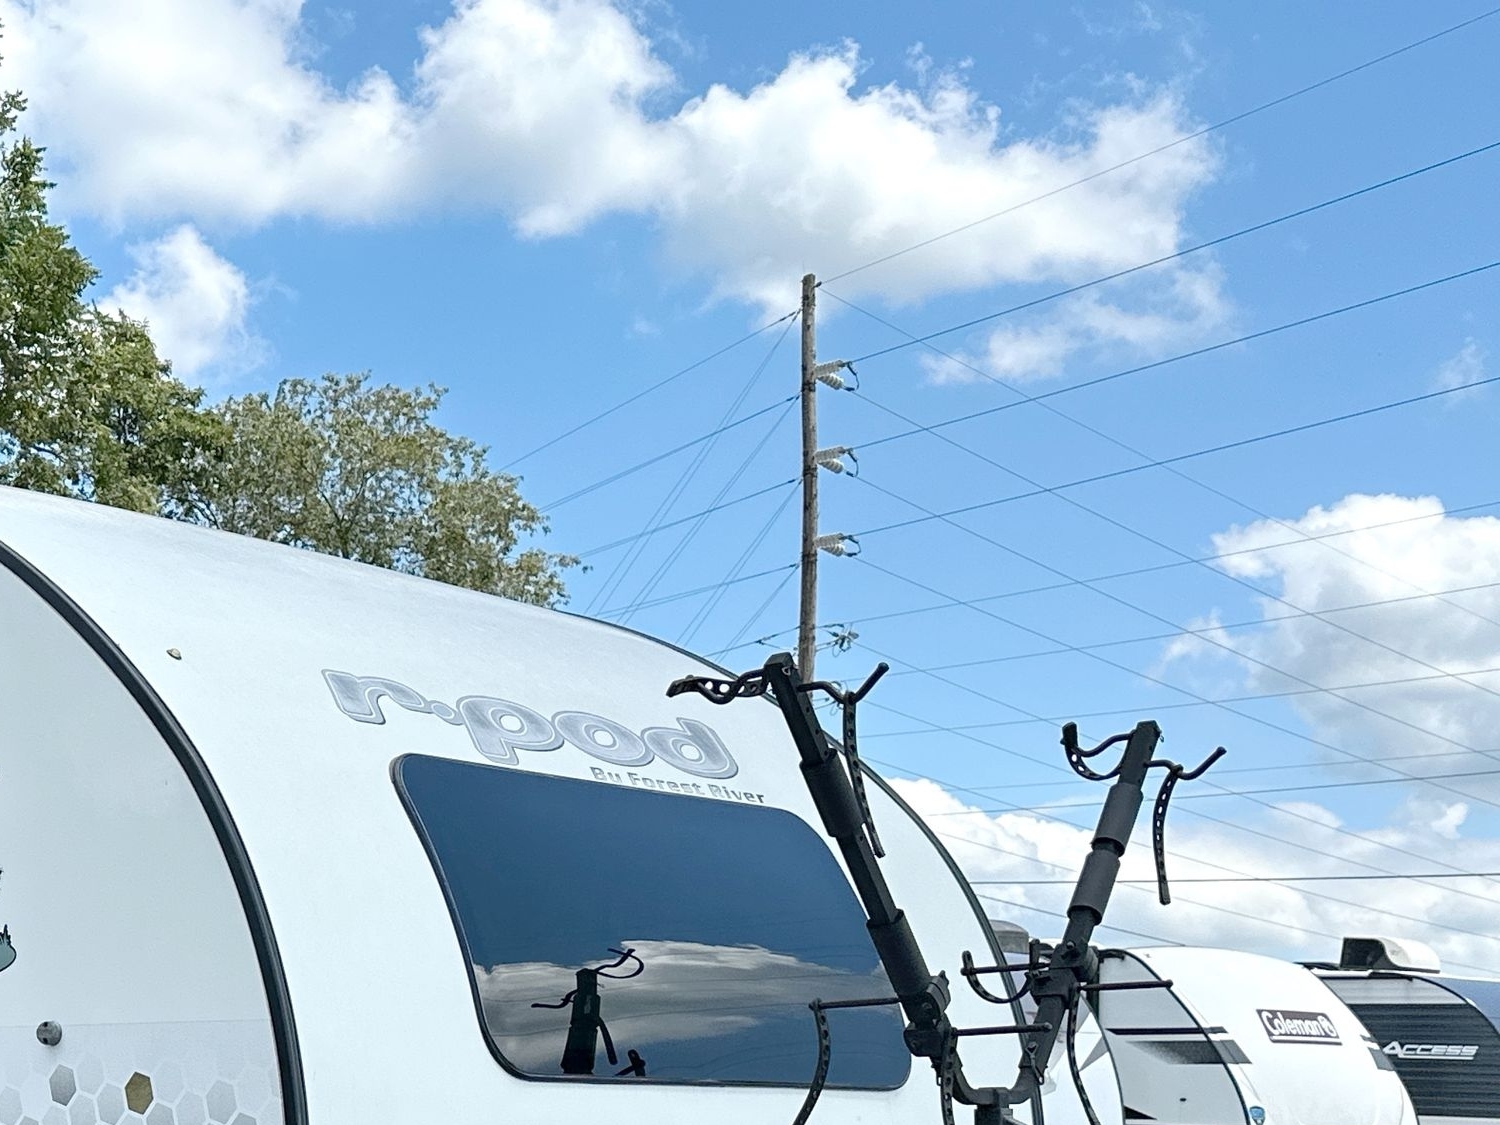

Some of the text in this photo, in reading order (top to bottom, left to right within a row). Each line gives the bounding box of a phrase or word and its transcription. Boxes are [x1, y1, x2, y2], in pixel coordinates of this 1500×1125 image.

[627, 771, 706, 796] Forest
[707, 783, 765, 804] River
[1261, 1010, 1326, 1036] Coleman
[1382, 1040, 1479, 1058] ACCESS
